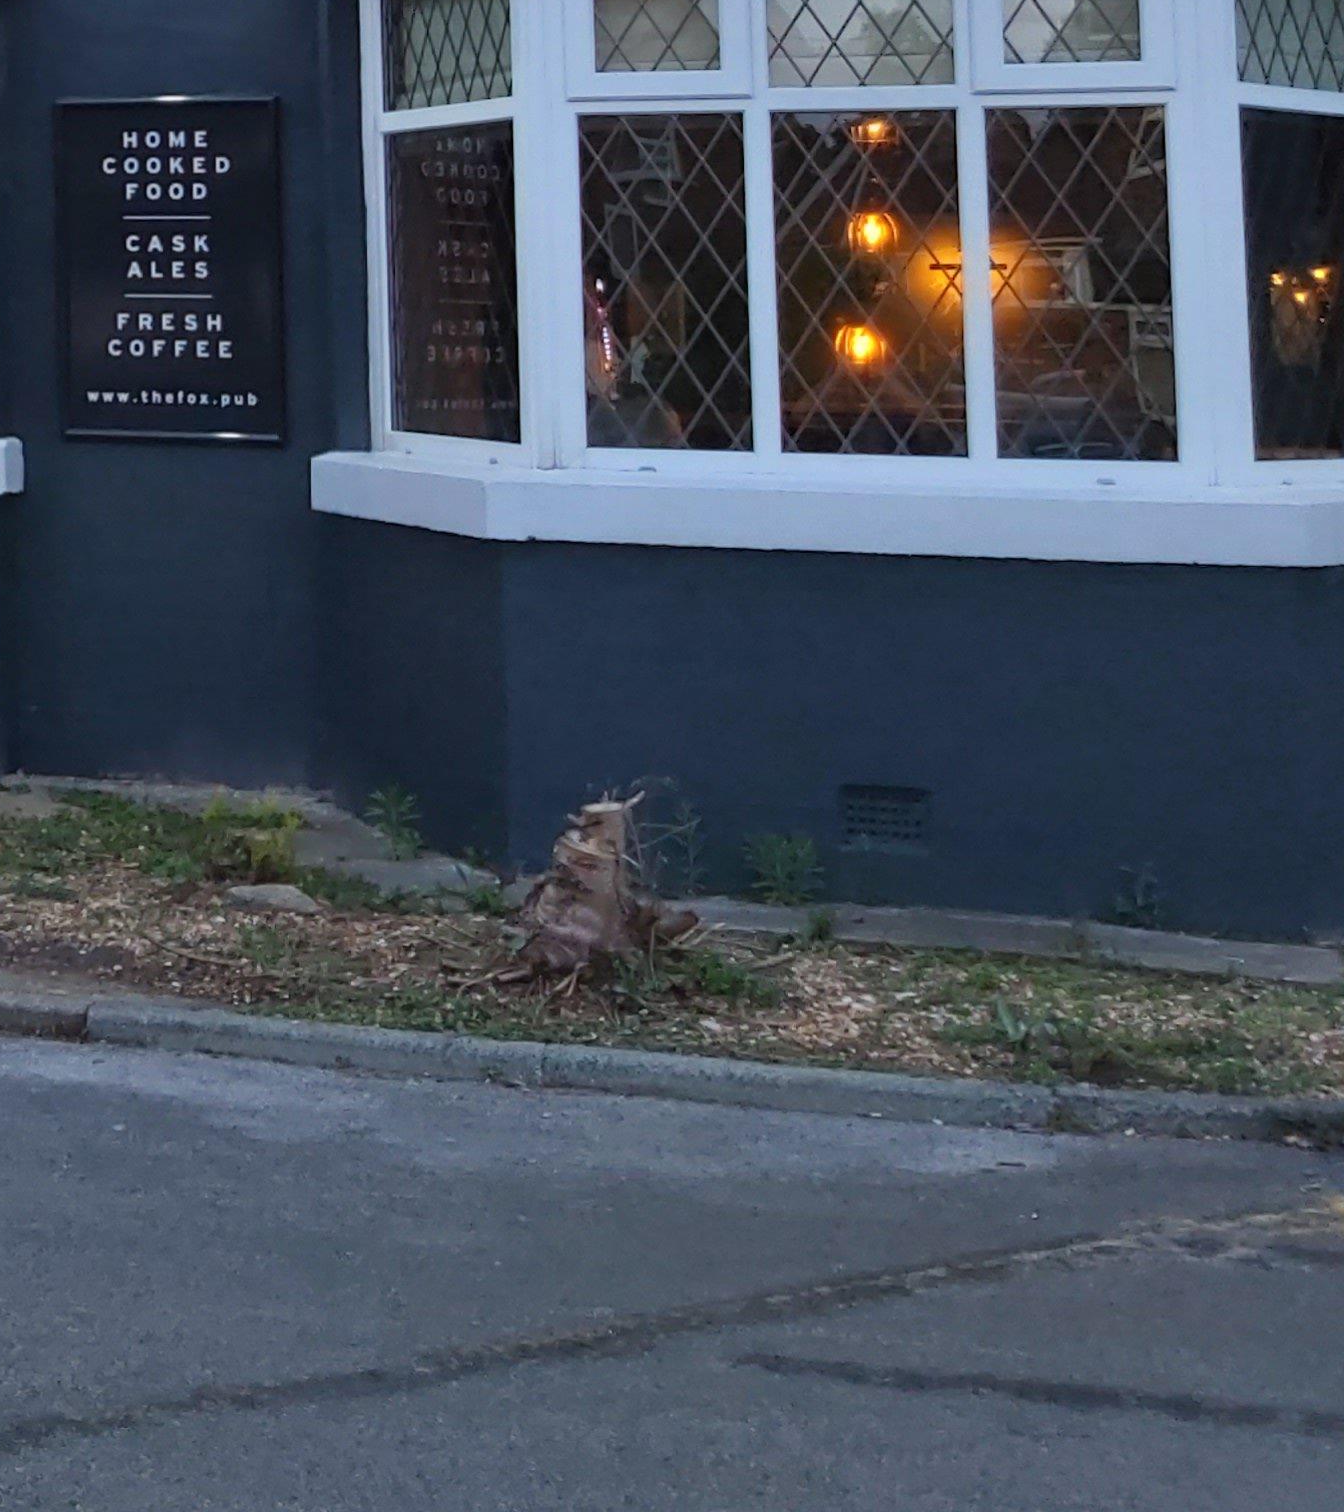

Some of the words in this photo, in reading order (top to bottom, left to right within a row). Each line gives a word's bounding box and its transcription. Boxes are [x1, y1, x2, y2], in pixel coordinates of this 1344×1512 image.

[122, 131, 209, 149] HOME
[102, 157, 231, 175] COOKED
[125, 183, 208, 201] FOOD
[125, 235, 210, 253] CASK
[126, 261, 209, 279] ALES
[116, 313, 222, 332] FRESH
[107, 339, 233, 359] COFFEE
[87, 390, 258, 407] www.thefox.pub
